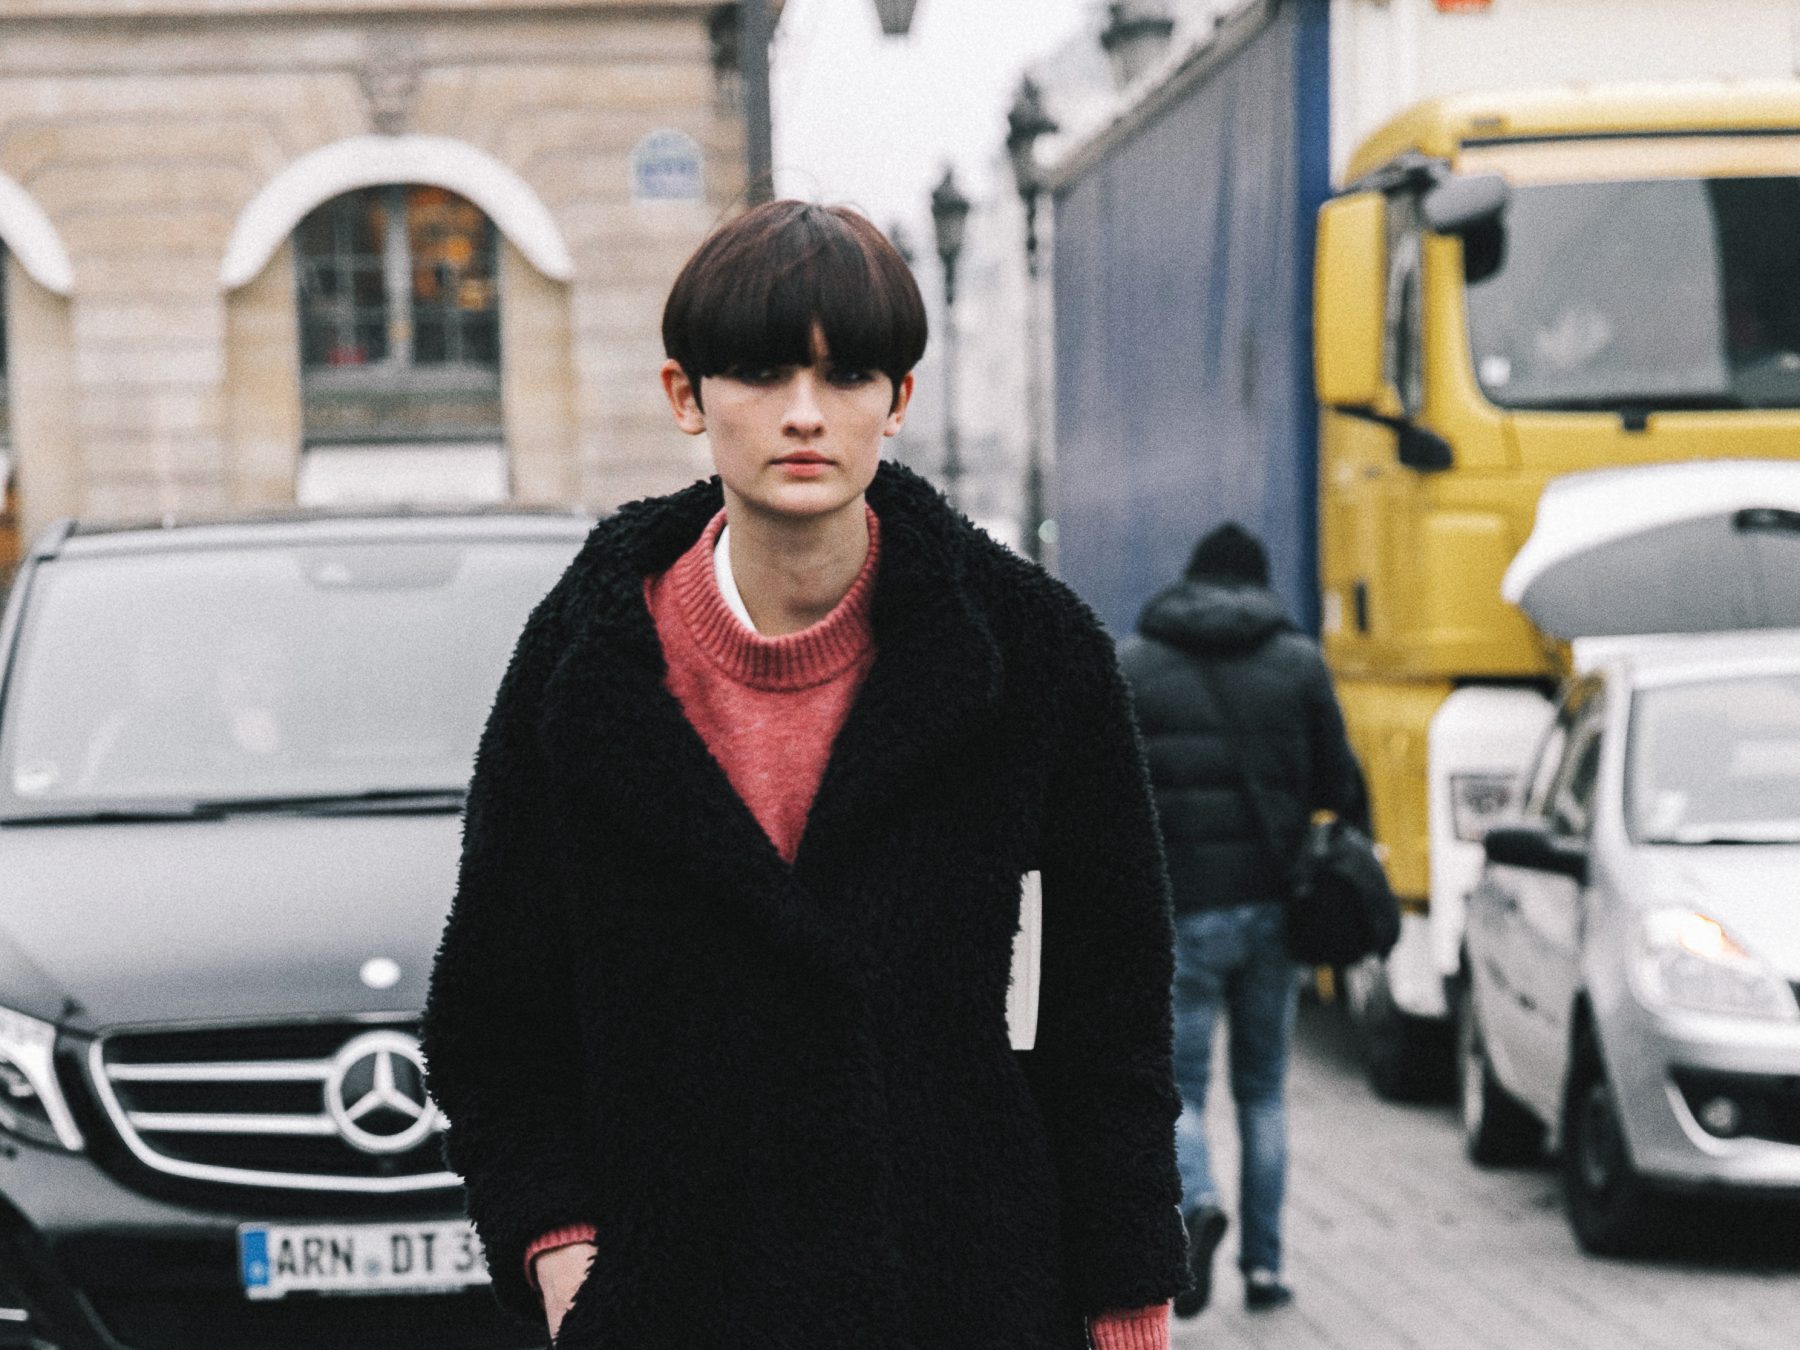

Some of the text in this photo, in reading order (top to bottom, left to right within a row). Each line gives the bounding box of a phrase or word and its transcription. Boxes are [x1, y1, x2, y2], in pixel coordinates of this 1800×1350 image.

[277, 1231, 484, 1277] ARN DT 3
